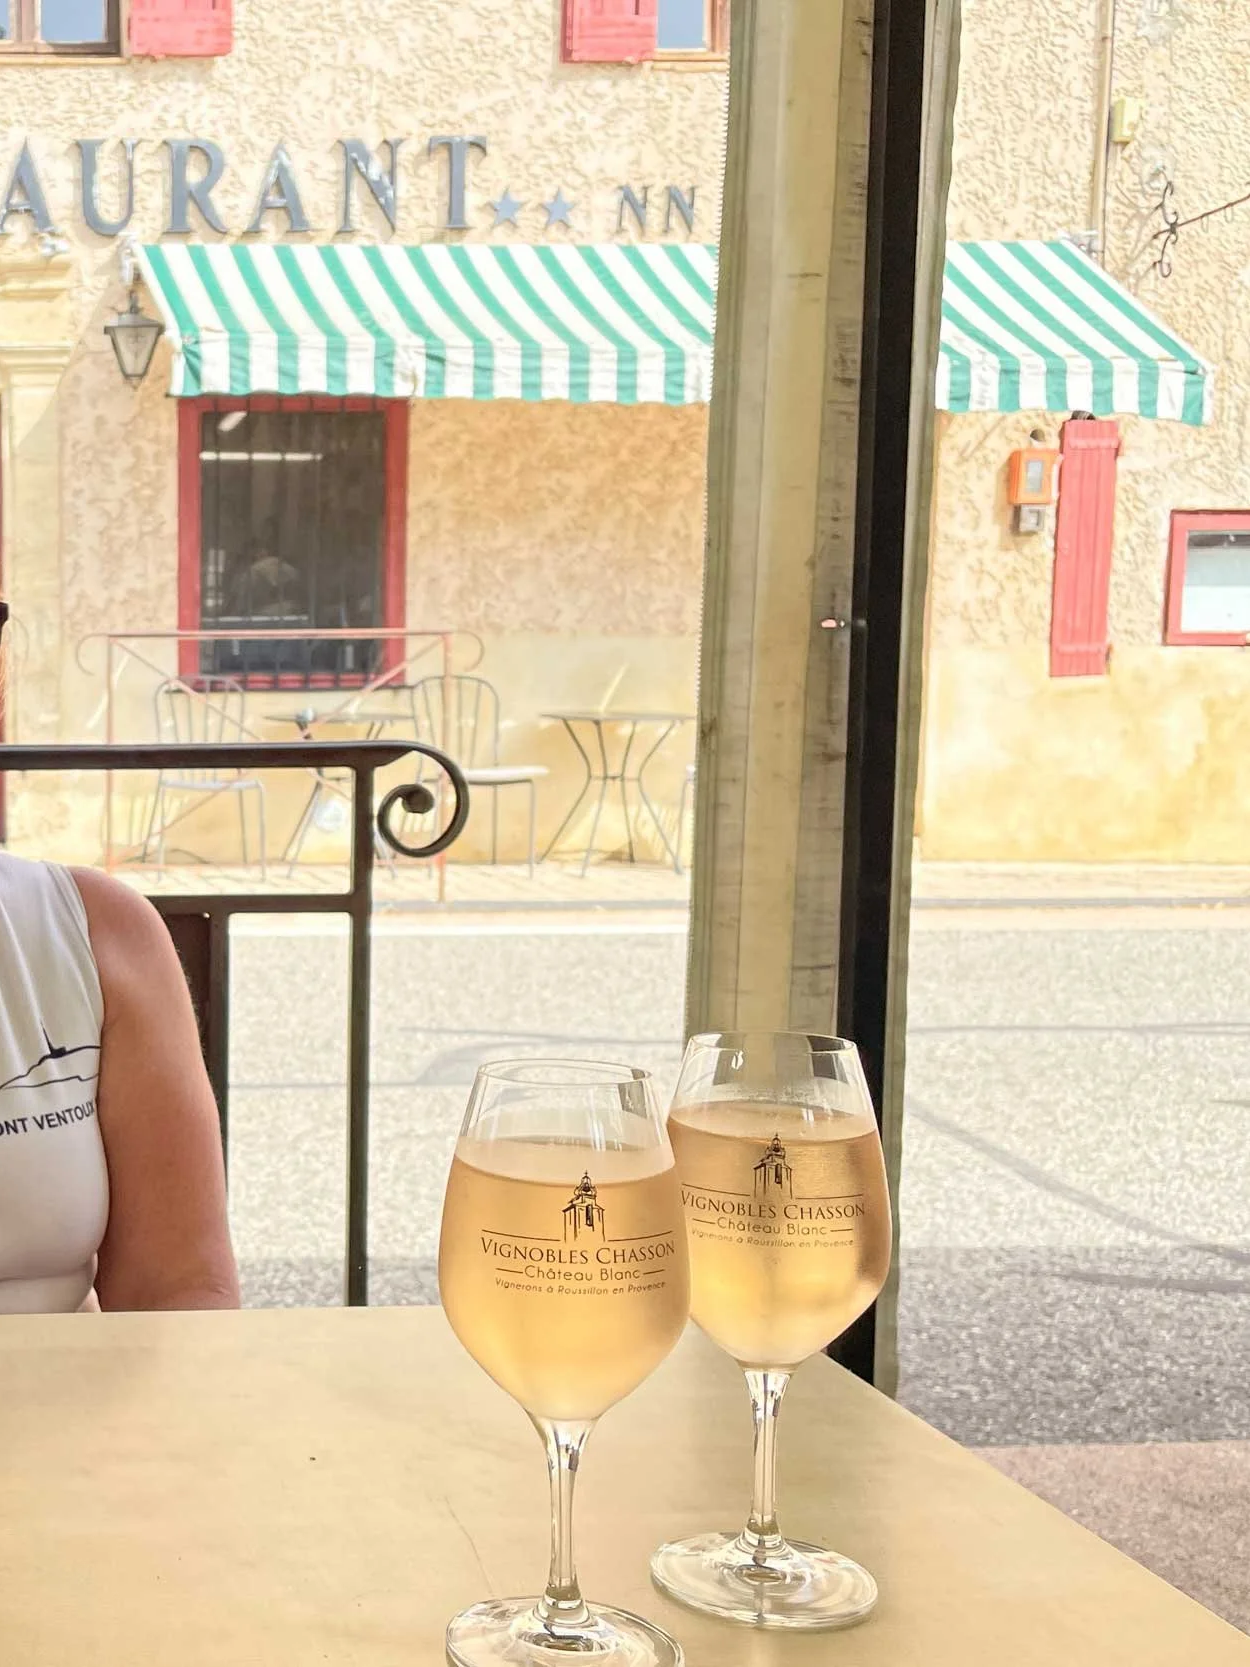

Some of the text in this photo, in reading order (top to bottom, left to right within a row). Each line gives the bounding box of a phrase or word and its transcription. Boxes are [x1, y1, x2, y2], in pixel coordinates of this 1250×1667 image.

[32, 1100, 95, 1131] VENTOUX
[680, 1190, 866, 1221] VIGNOBLES CHASSON
[716, 1216, 827, 1236] Château Blanc
[480, 1236, 676, 1265] VIGNOBLES CHASSON
[524, 1264, 641, 1282] Château Blanc
[495, 1278, 667, 1296] Vignerons à Roussillon en Provence
